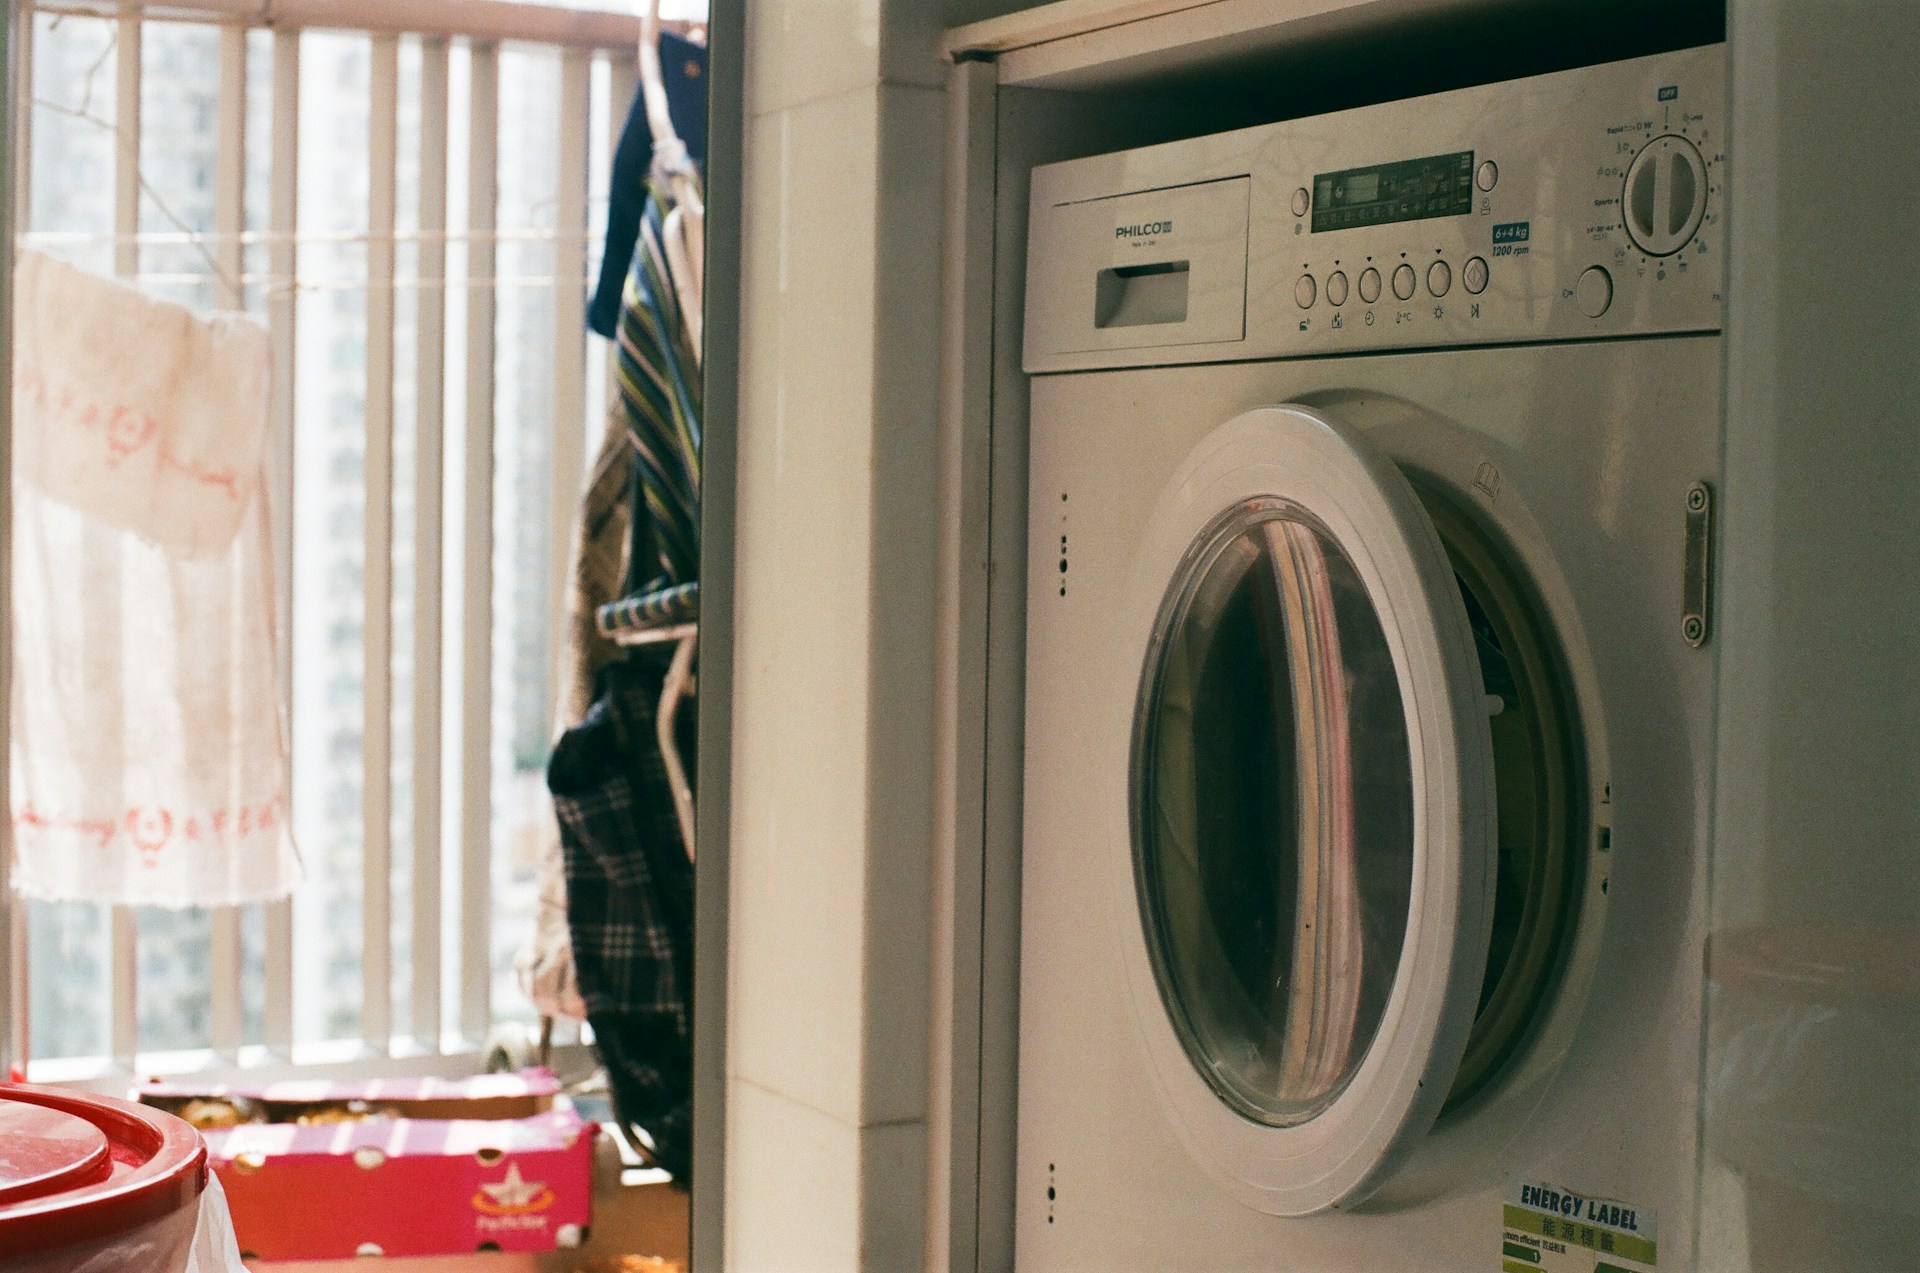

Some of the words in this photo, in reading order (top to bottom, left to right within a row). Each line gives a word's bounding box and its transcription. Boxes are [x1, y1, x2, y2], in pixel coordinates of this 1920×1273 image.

[1660, 88, 1677, 99] OFF
[1116, 222, 1161, 238] PHILCO
[1495, 227, 1514, 239] 6+4
[1516, 226, 1527, 239] kg
[1493, 245, 1512, 257] 1200
[1513, 246, 1529, 257] rpm
[1521, 1184, 1583, 1218] ENERGY
[1587, 1201, 1638, 1231] LABEL
[1533, 1251, 1539, 1262] 1
